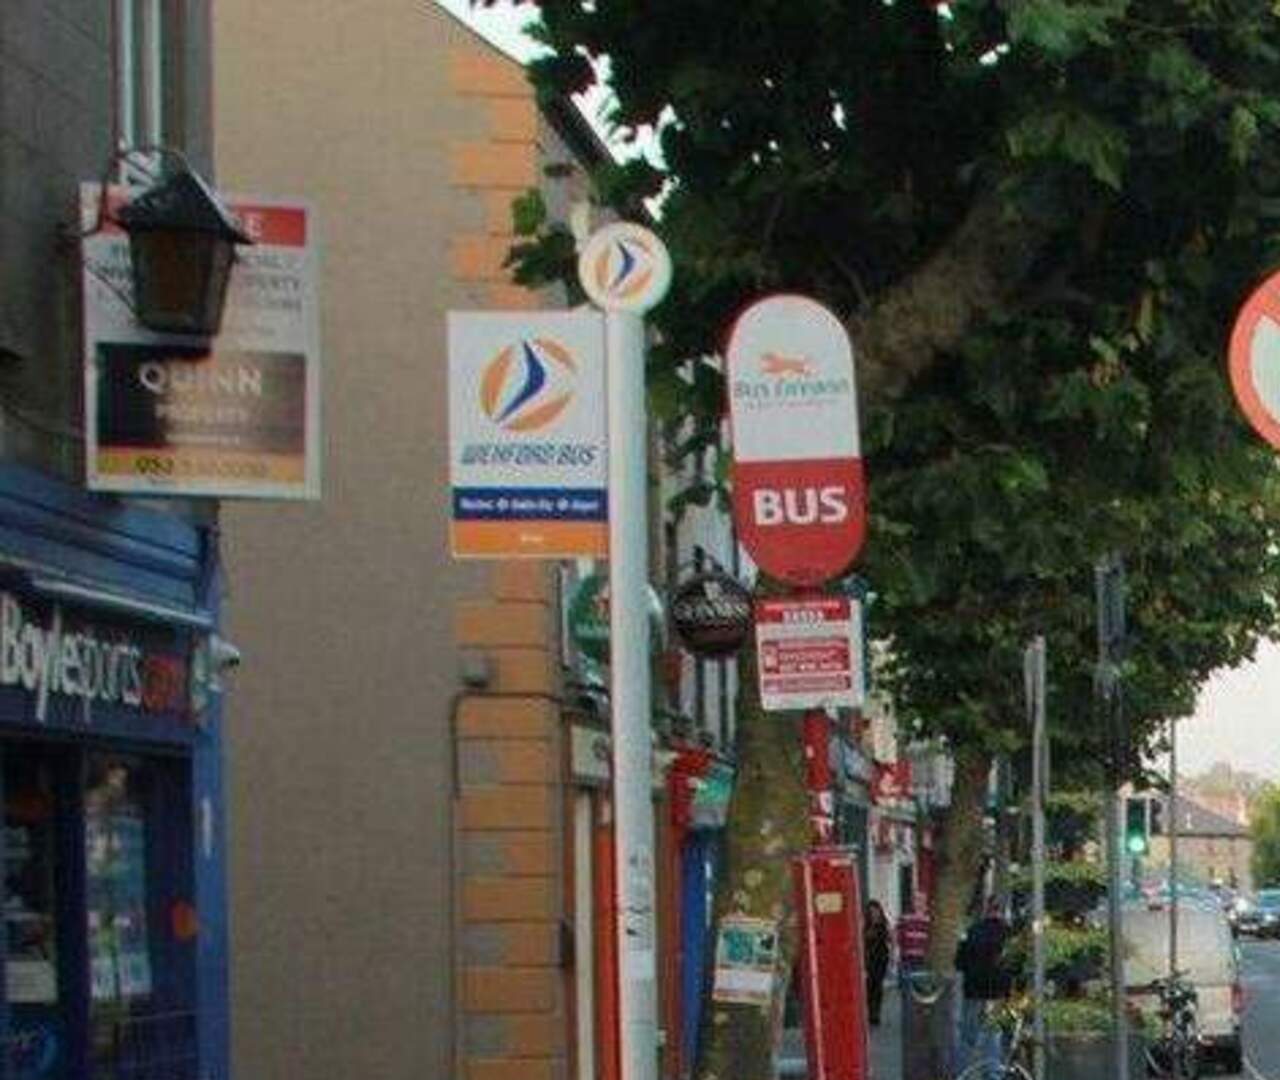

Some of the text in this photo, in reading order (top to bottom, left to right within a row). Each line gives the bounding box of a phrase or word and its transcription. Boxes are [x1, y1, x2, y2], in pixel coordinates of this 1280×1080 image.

[140, 362, 262, 395] QUINN
[555, 442, 600, 468] BUS
[753, 487, 848, 526] BUS
